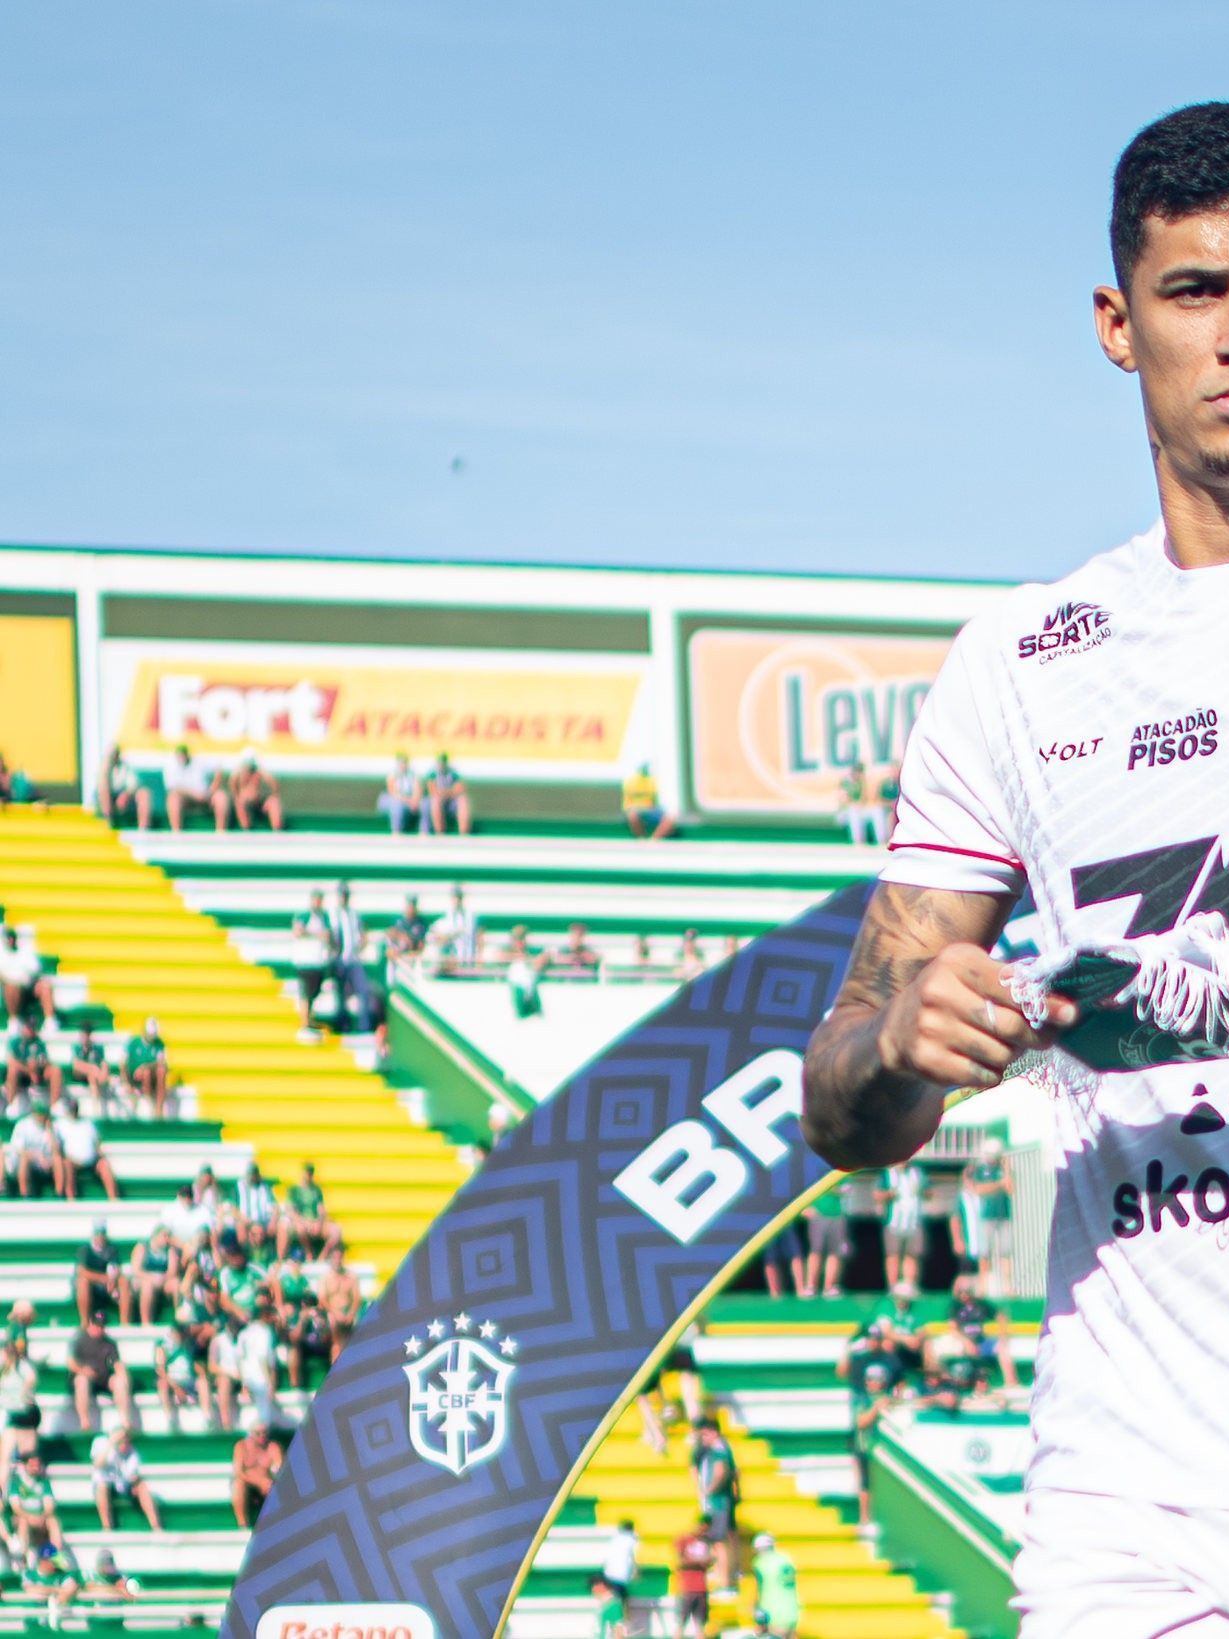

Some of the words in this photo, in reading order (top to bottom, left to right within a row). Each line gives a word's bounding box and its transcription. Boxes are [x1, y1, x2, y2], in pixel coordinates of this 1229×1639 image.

[1018, 611, 1112, 659] SORTE
[158, 673, 328, 744] Fort
[341, 710, 608, 743] ATACADISTA
[1131, 708, 1218, 743] ATACADÃO
[1127, 729, 1218, 771] PISOS
[612, 1048, 806, 1247] BR
[437, 1393, 476, 1409] CBF
